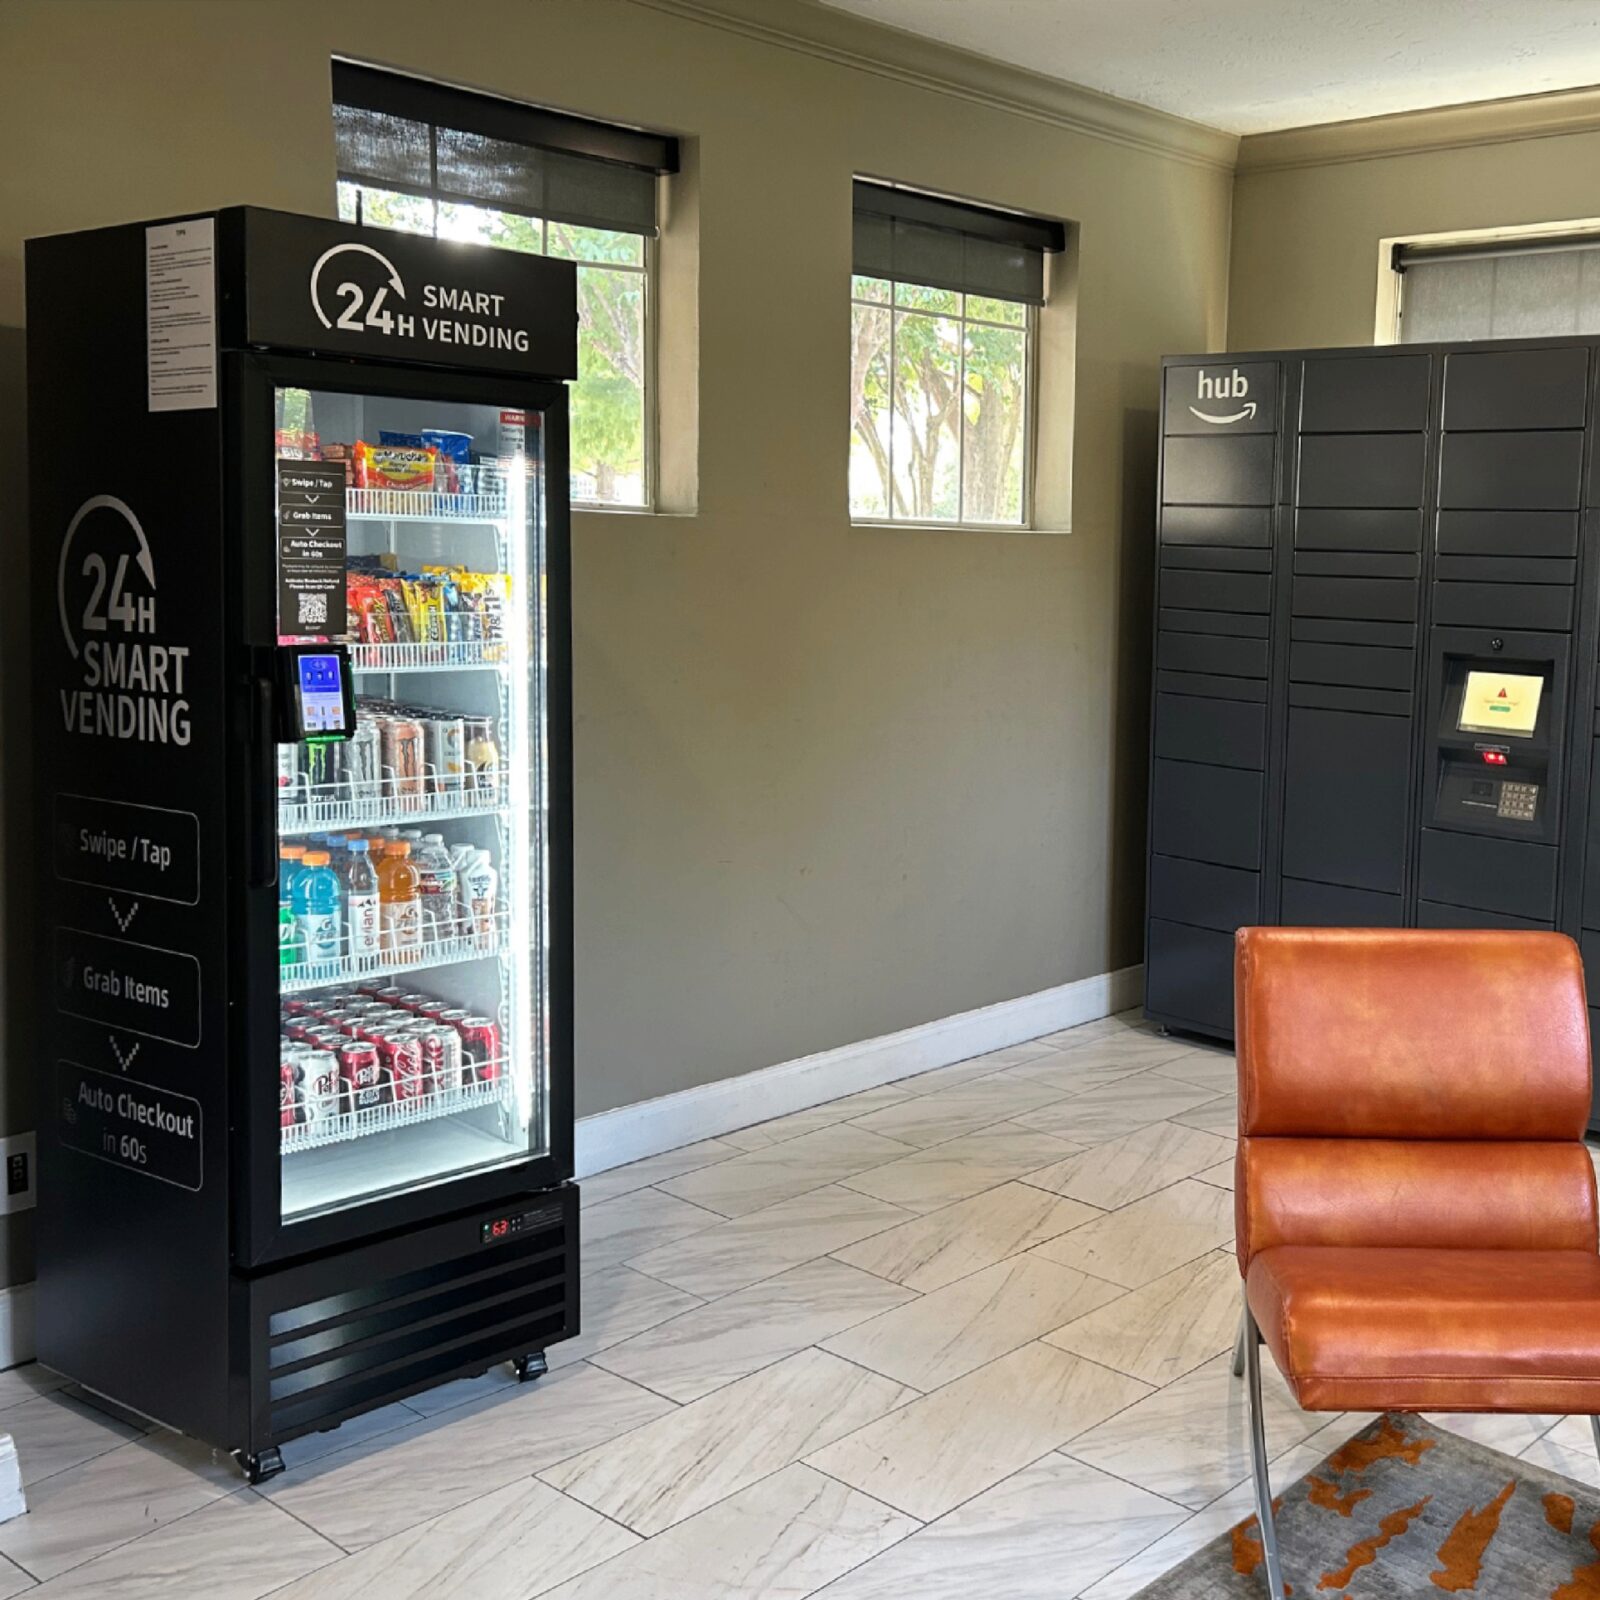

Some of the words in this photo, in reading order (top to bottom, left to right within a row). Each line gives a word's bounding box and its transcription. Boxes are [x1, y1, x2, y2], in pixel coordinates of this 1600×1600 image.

[336, 282, 415, 338] 24H
[423, 284, 505, 317] SMART
[422, 317, 529, 352] VENDING
[1198, 368, 1249, 399] hub
[292, 478, 314, 488] Swipe
[319, 480, 333, 489] Tap
[293, 511, 311, 520] Grab
[312, 512, 332, 521] Items
[291, 540, 308, 548] Auto
[309, 540, 342, 549] Checkout
[82, 552, 156, 634] 24H
[84, 640, 190, 695] SMART
[60, 688, 191, 746] VENDING
[80, 828, 127, 862] Swipe
[131, 836, 138, 860] /
[140, 838, 171, 872] Tap
[83, 966, 121, 996] Grab
[124, 975, 169, 1008] Items
[78, 1081, 114, 1113] Auto
[117, 1094, 194, 1139] Checkout
[103, 1127, 116, 1154] in
[120, 1134, 147, 1164] 60s
[492, 1219, 509, 1236] 63
